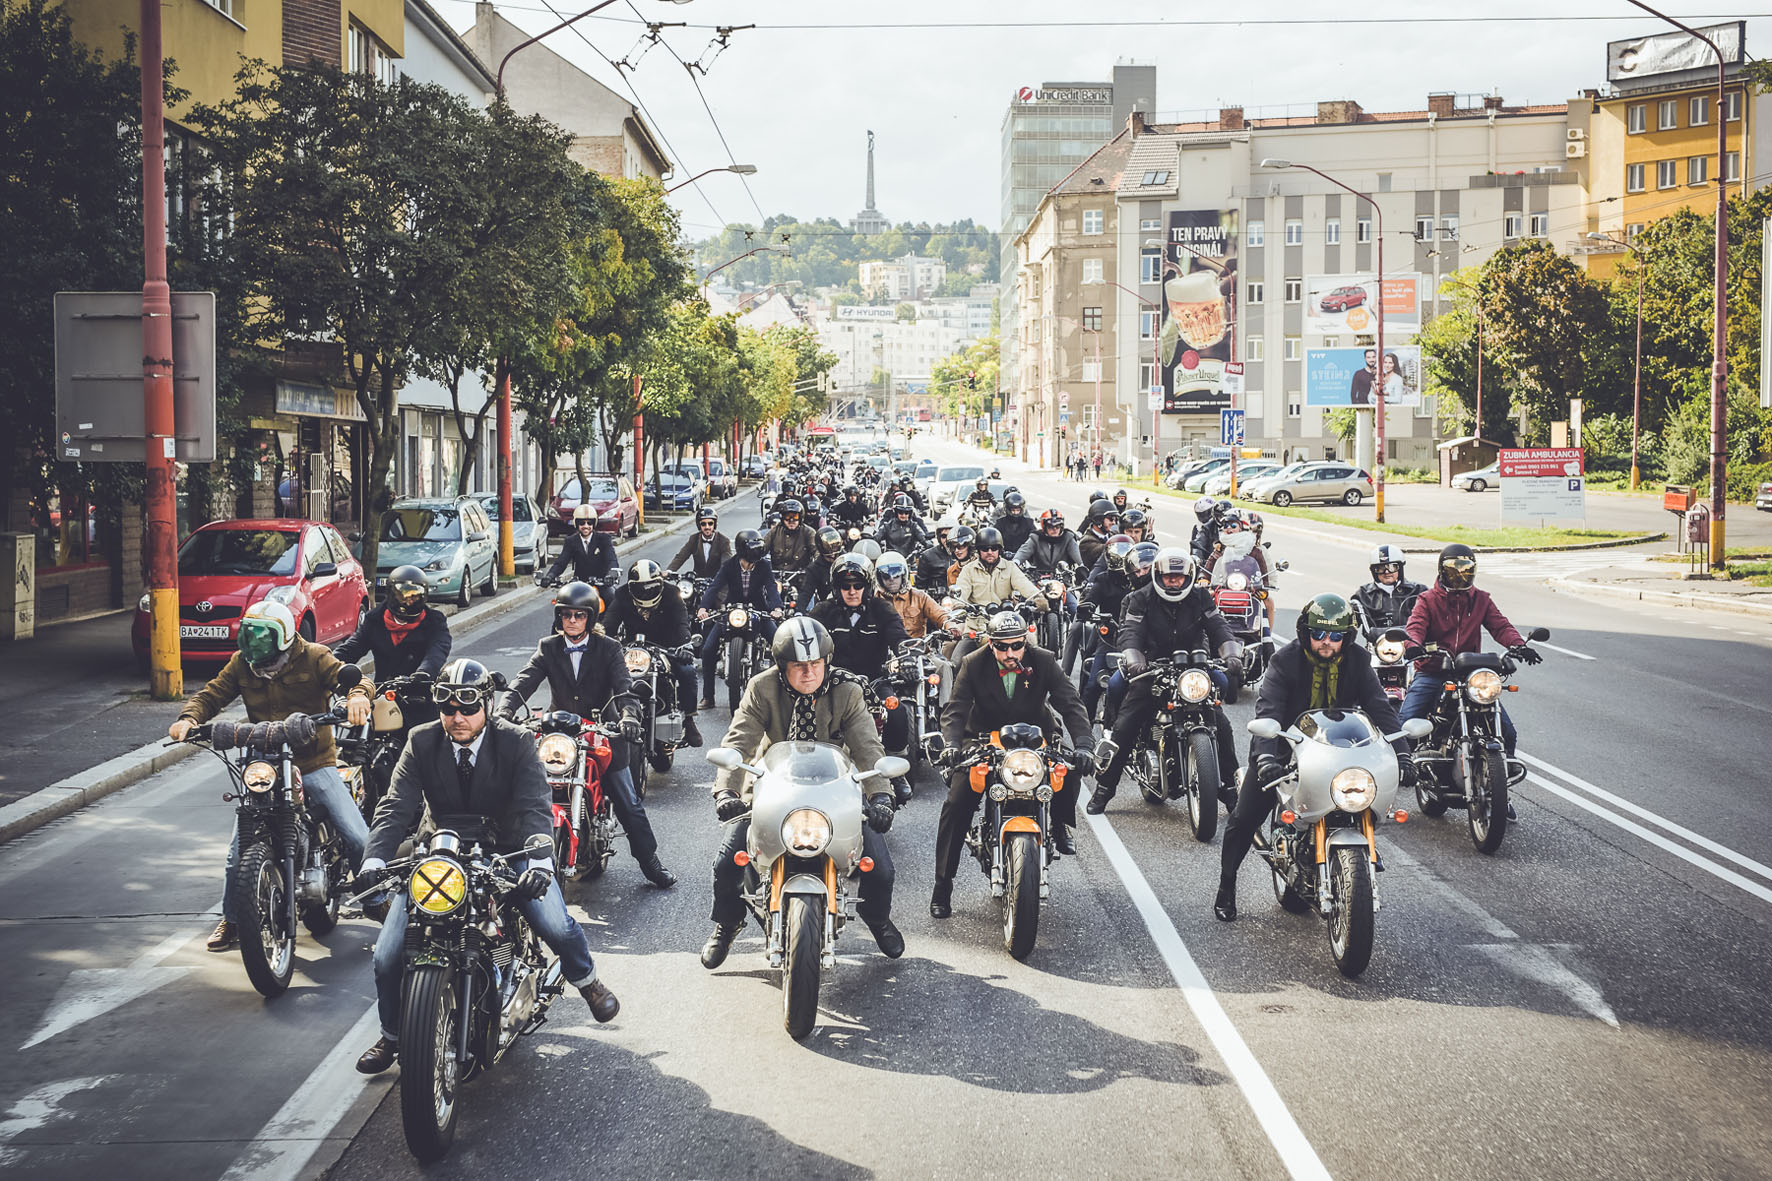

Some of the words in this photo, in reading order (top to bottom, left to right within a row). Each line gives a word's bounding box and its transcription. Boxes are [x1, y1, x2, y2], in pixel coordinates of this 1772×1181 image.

[1035, 90, 1079, 100] UniCredit
[1082, 90, 1108, 100] Bank
[1171, 227, 1192, 241] TEN
[1176, 241, 1225, 258] ORIGINÁL
[1503, 450, 1530, 459] ZUBNÁ
[1531, 450, 1580, 459] AMBULANCIA
[181, 627, 193, 637] BA
[198, 627, 228, 637] 241TK
